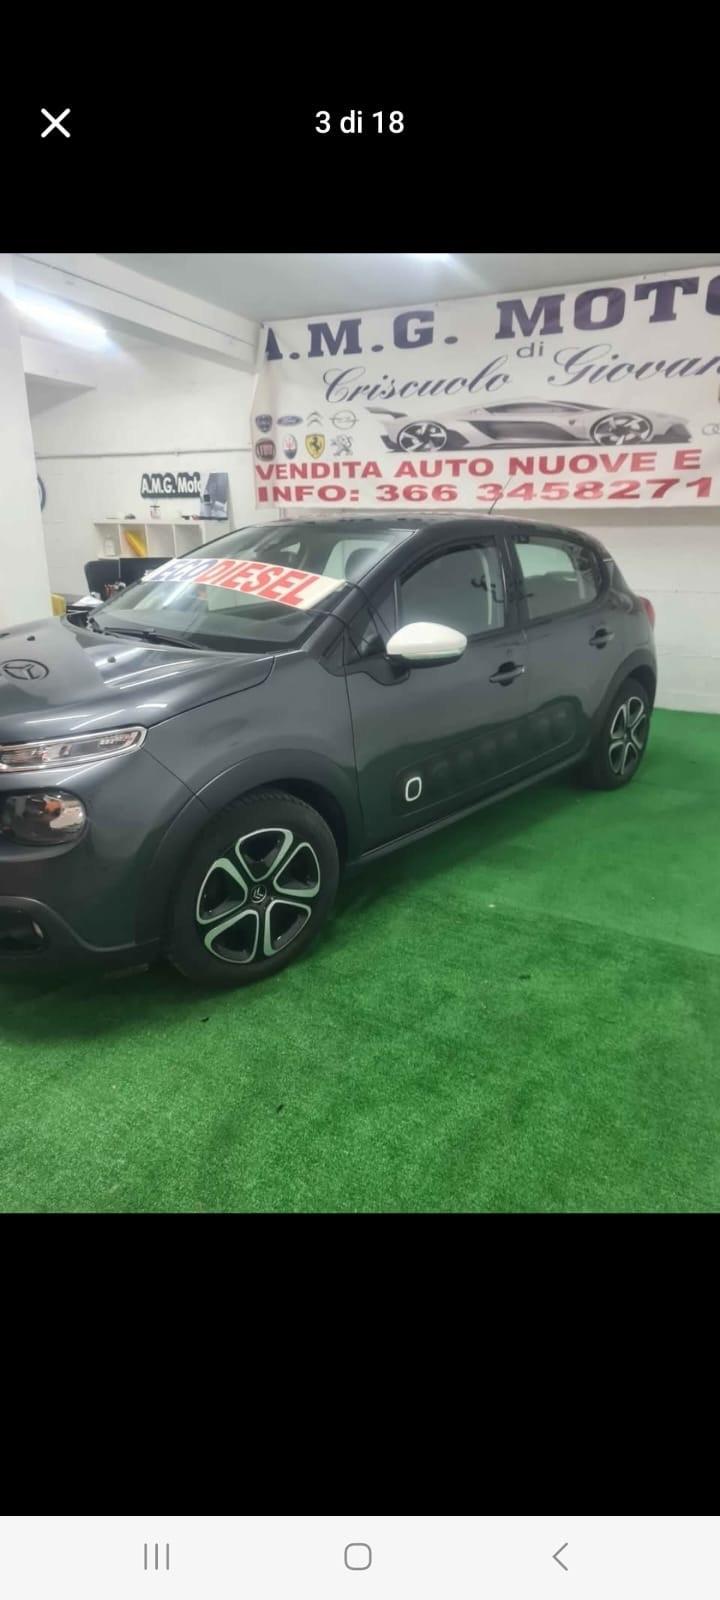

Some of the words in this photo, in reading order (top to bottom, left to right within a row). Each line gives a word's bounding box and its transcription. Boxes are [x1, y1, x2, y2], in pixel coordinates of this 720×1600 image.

[494, 275, 720, 340] MOT
[516, 341, 544, 358] di
[323, 354, 511, 403] Criscuolo
[256, 461, 383, 480] VENDITA
[394, 458, 494, 478] AUTO
[508, 451, 657, 476] NUOVE
[673, 449, 703, 471] E
[141, 477, 176, 494] A.M.G.
[257, 484, 360, 503] INFO:
[375, 483, 459, 502] 366
[475, 476, 713, 502] 3458271
